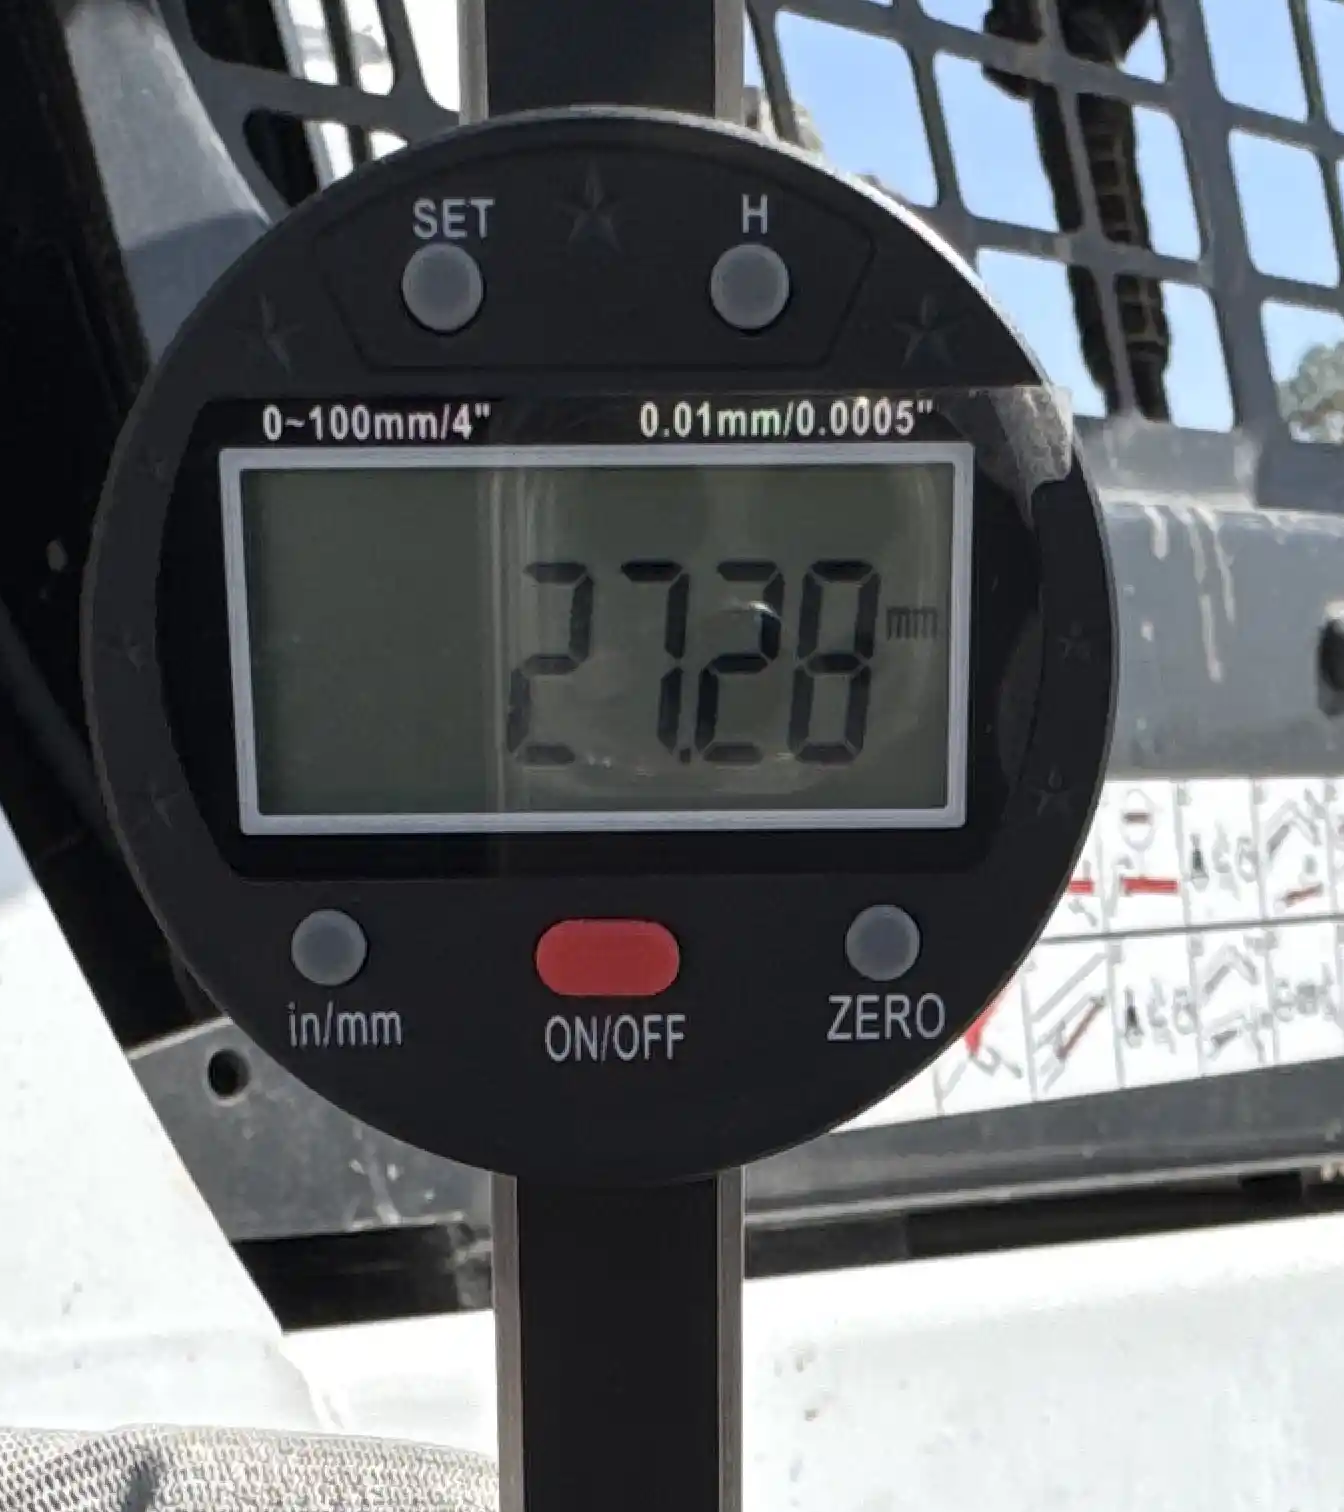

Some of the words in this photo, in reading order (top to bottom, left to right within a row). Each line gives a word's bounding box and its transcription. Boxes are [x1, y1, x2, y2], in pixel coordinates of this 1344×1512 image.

[412, 197, 494, 239] SET
[741, 194, 769, 234] H
[262, 403, 491, 442] 0~100mm/4"
[639, 400, 934, 438] 0.01mm/0.0005"
[507, 560, 880, 764] 27.28
[886, 605, 938, 640] mm
[288, 1002, 403, 1048] in/mm
[545, 1014, 686, 1062] ON/OFF
[827, 993, 946, 1041] ZERO
